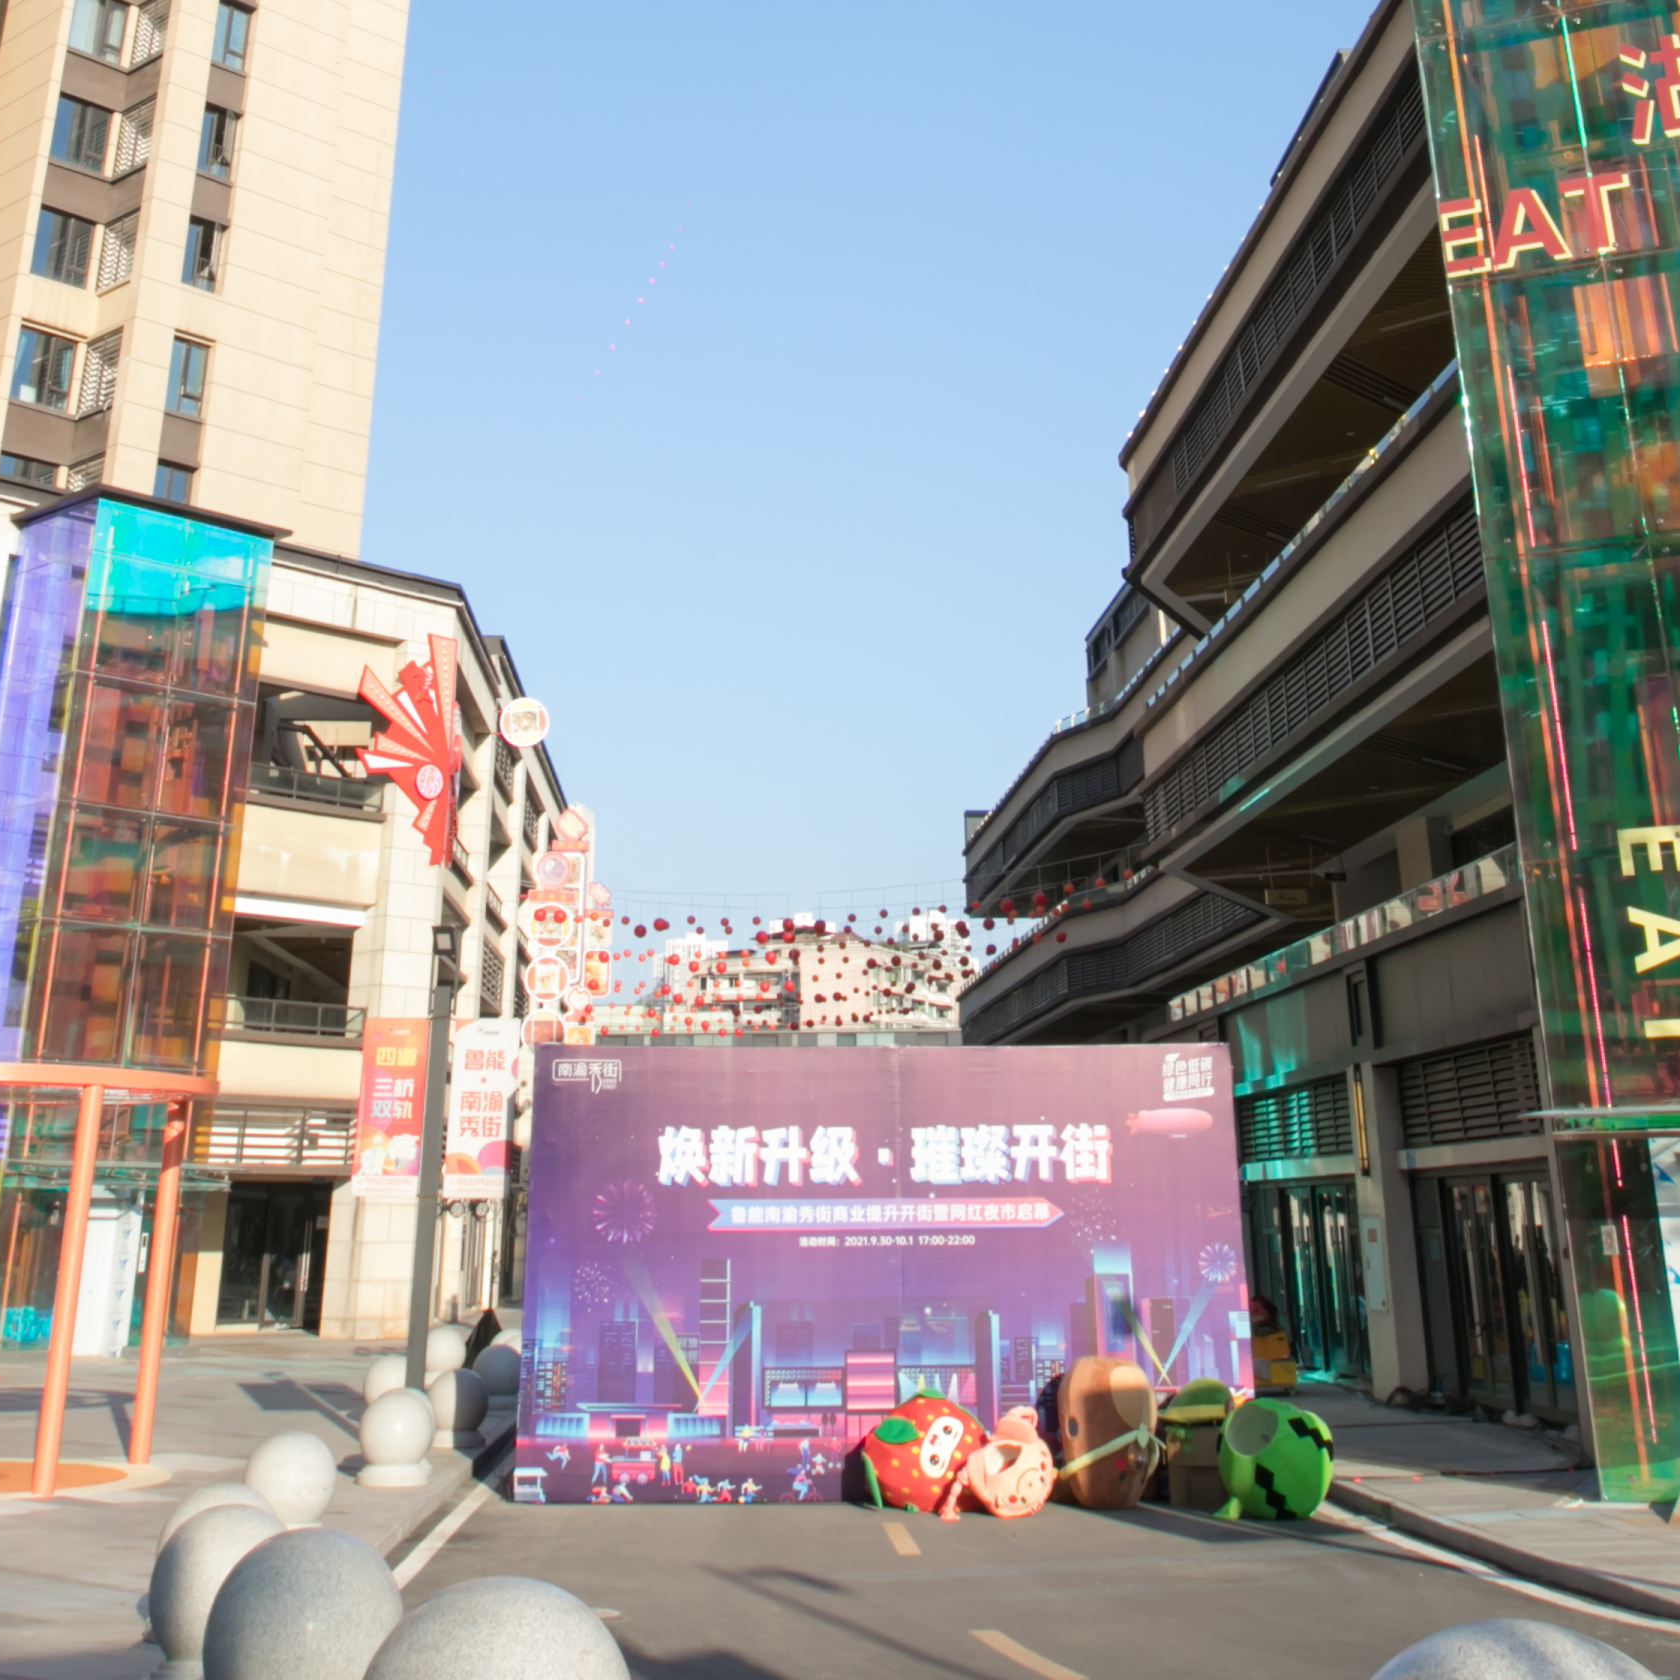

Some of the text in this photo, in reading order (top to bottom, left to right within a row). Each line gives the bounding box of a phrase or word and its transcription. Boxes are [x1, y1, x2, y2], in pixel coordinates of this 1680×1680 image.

[1439, 172, 1631, 279] EAT
[375, 1046, 418, 1067] 四道
[464, 1049, 507, 1071] 鲁能
[373, 1078, 416, 1098] 三桥
[371, 1099, 413, 1120] 双轨
[460, 1091, 503, 1113] 南渝
[459, 1115, 502, 1138] 秀街
[730, 1202, 1051, 1224] 鲁能南渝秀街商业提升开街暨网红夜市启幕
[917, 1234, 976, 1247] 17:00-22:00
